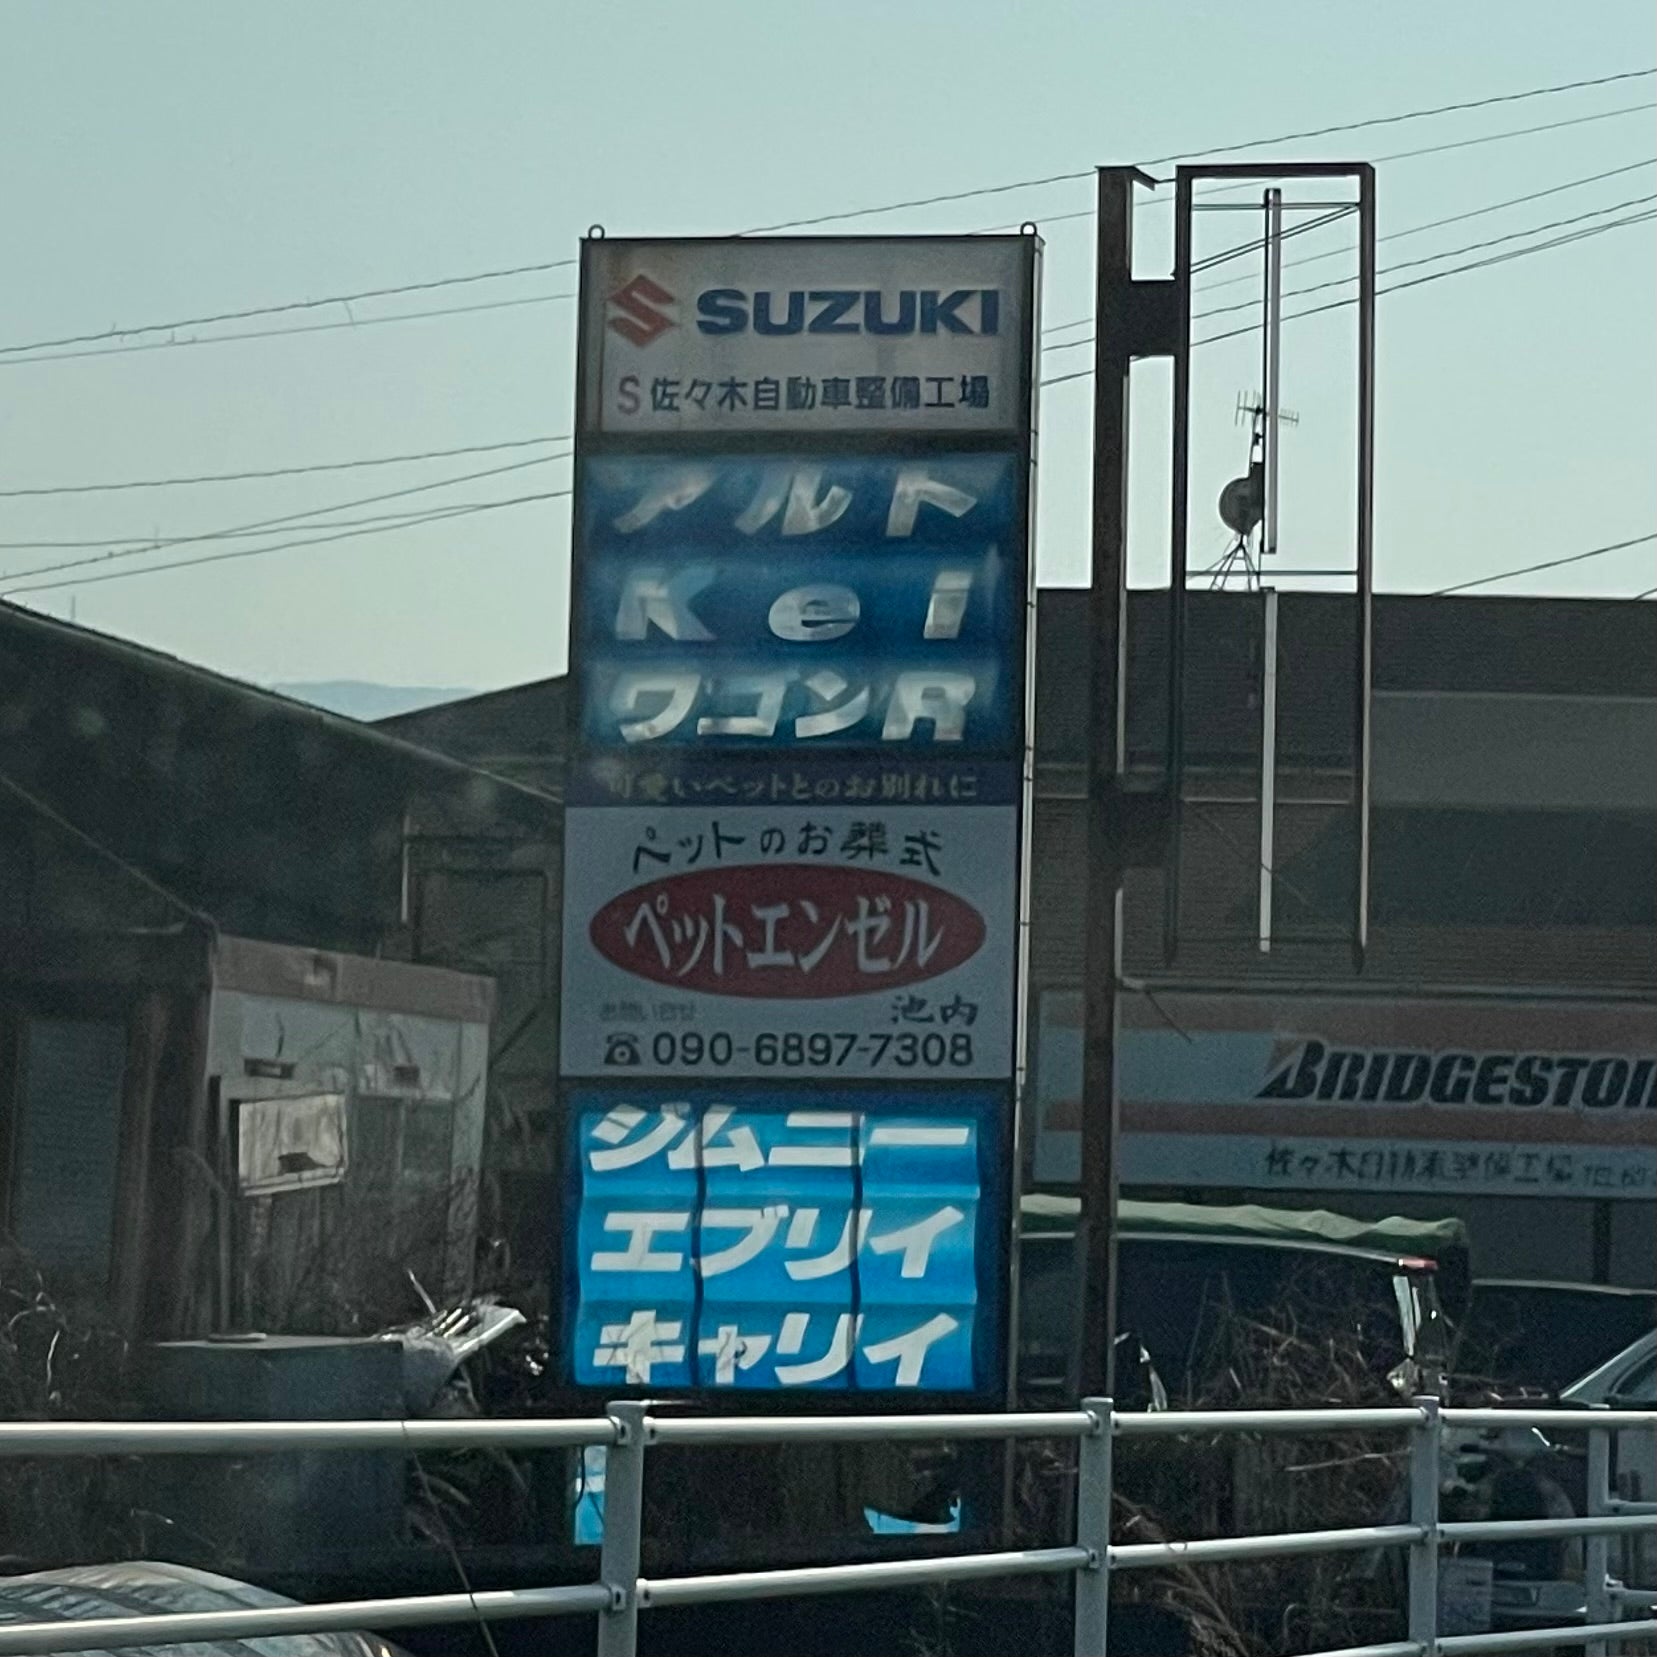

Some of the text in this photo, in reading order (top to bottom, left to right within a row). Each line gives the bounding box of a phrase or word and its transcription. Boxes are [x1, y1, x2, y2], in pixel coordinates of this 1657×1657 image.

[696, 288, 1000, 336] SUZUKI
[651, 375, 991, 412] 佐々木自動車整備工場
[633, 821, 943, 877] ペットのお葬式
[623, 893, 945, 976] ペットエンゼル
[890, 994, 979, 1026] 池内
[652, 1031, 974, 1067] 090-6897-7308
[589, 1103, 970, 1172] ジムニー
